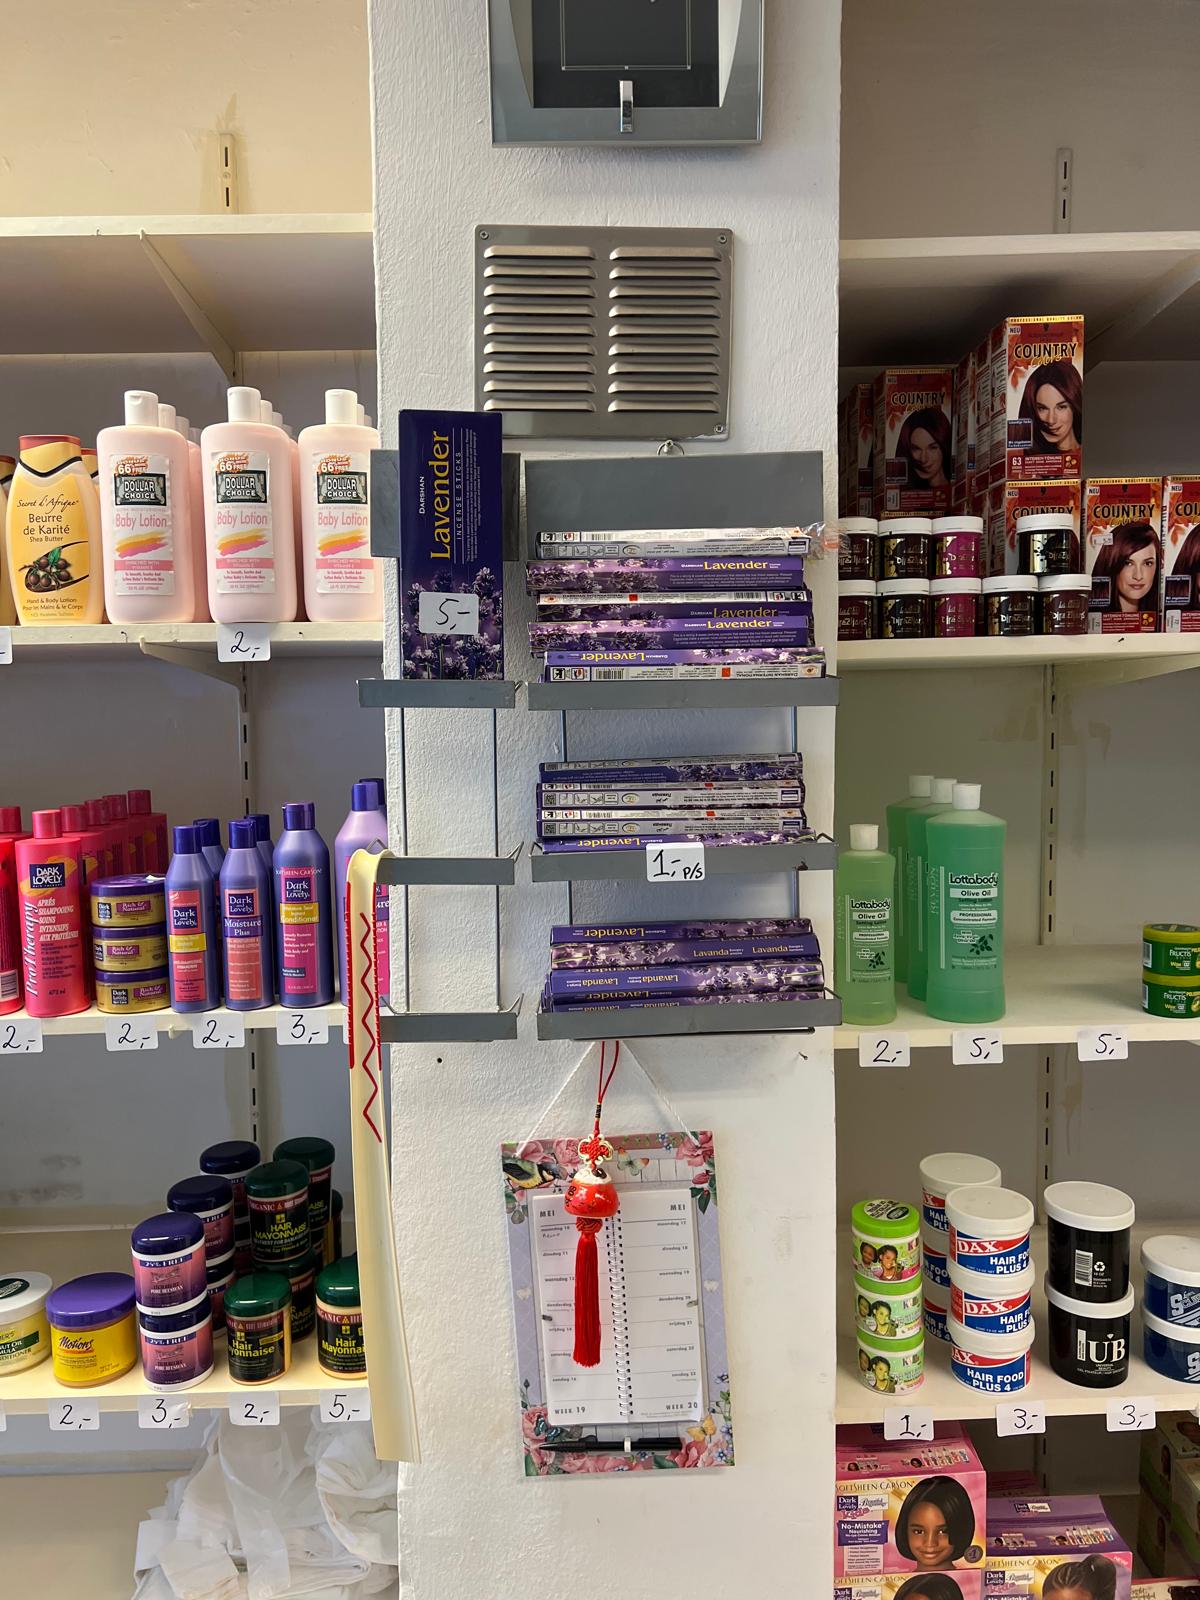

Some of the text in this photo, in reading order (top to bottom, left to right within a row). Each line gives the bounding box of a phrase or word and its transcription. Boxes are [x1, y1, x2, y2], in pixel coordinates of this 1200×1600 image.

[1015, 342, 1077, 359] COUNTRY
[891, 392, 945, 405] COUNTRY
[1012, 456, 1022, 466] 63
[124, 480, 155, 491] DOLLAR
[225, 477, 255, 489] DOLLAR
[327, 479, 357, 490] DOLLAR
[429, 431, 450, 560] Lavender
[17, 499, 37, 508] Secret
[1093, 504, 1155, 519] COUNTRY
[28, 513, 62, 523] Beurre
[115, 514, 167, 530] Baby Lotion
[217, 511, 268, 528] Baby Lotion
[318, 512, 368, 529] Baby Lotion
[23, 524, 70, 535] de Karité
[704, 560, 768, 570] Lavender
[713, 607, 777, 618] Lavender
[707, 619, 772, 629] Lavender
[230, 631, 261, 659] 2,-
[581, 651, 645, 662] Lavender
[578, 837, 641, 848] Lavender
[36, 866, 60, 877] DARK
[33, 874, 63, 885] LOVELY
[286, 880, 309, 889] Dark
[949, 872, 998, 887] Lottabody
[286, 890, 309, 899] Lovely
[961, 889, 980, 897] Olive
[229, 896, 252, 904] Dark
[851, 898, 890, 910] Lottabody
[173, 909, 195, 918] Dark
[230, 905, 253, 913] Lovely
[174, 919, 196, 927] Lovely
[224, 918, 262, 927] Moisture
[585, 927, 645, 938] Lavender
[693, 948, 729, 957] Lavanda
[752, 945, 788, 954] Lavanda
[583, 978, 618, 986] Lavanda
[643, 974, 678, 983] Lavanda
[587, 990, 650, 1000] Lavender
[202, 1019, 236, 1047] 2,-
[290, 1015, 320, 1044] 3,-
[2, 1025, 36, 1050] 2,-
[118, 1023, 151, 1048] 2,-
[872, 1040, 902, 1063] 2,-
[670, 1203, 686, 1211] MEI
[540, 1209, 555, 1217] MEI
[270, 1222, 292, 1232] HAIR
[957, 1240, 998, 1254] DAX
[989, 1255, 1016, 1266] HAIR
[930, 1265, 950, 1279] FOO
[996, 1264, 1021, 1274] PLUS
[935, 1275, 942, 1284] 4
[966, 1299, 1008, 1315] DAX
[1000, 1313, 1023, 1326] HAIR
[1006, 1319, 1028, 1333] PLUS
[335, 1338, 356, 1347] Hair
[944, 1332, 951, 1342] 4
[11, 1340, 23, 1348] OIL
[59, 1335, 94, 1351] Motions
[232, 1339, 252, 1350] Hair
[967, 1368, 1024, 1384] HAIR FOOD
[972, 1379, 1011, 1392] PLUS 4
[243, 1402, 270, 1423] 2,-
[329, 1394, 361, 1421] 5,-
[666, 1403, 684, 1411] WEEK
[60, 1404, 91, 1429] 2,-
[151, 1398, 181, 1428] 3,-
[1119, 1404, 1150, 1428] 3,-
[1013, 1408, 1039, 1430] 3,-
[838, 1496, 857, 1504] Dark
[841, 1522, 882, 1530] No-Mistake
